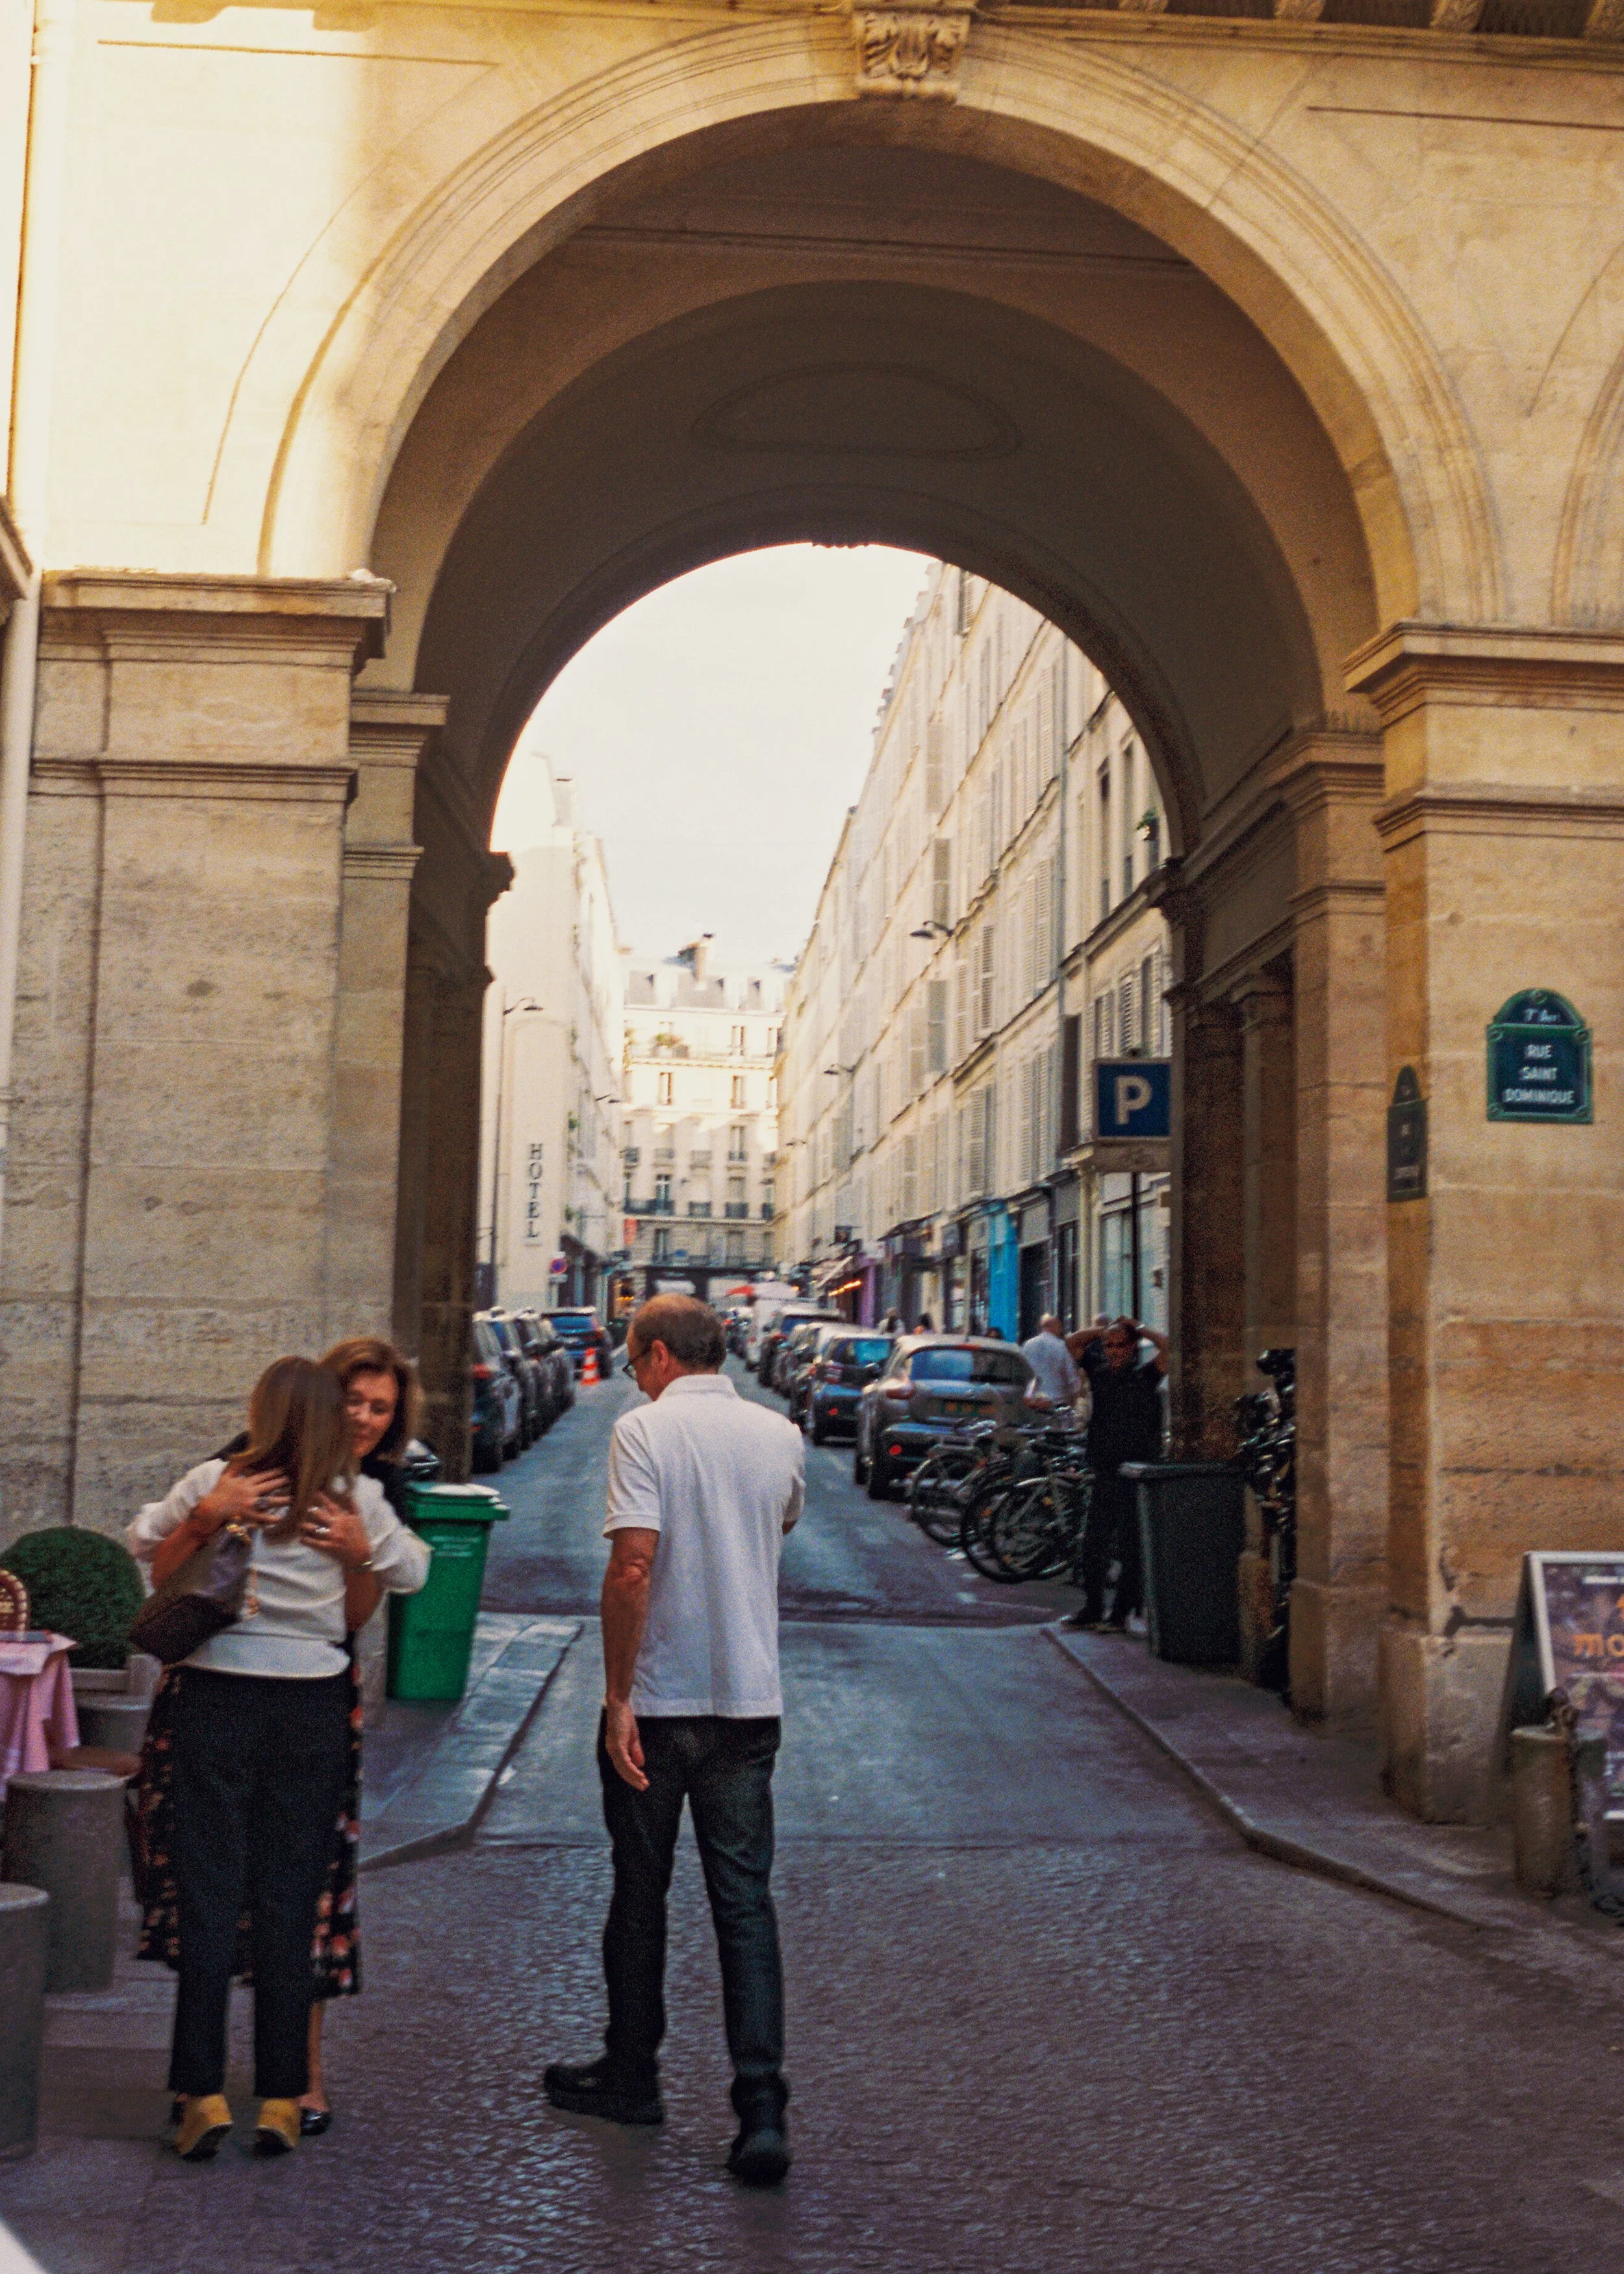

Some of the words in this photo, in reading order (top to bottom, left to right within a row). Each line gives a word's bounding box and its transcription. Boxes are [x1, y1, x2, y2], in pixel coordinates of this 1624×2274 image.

[1525, 1043, 1552, 1059] RUE
[1519, 1066, 1558, 1080] SAINT
[1115, 1075, 1152, 1125] P
[1502, 1088, 1575, 1105] DOMINIQUE
[527, 1143, 543, 1238] HOTEL
